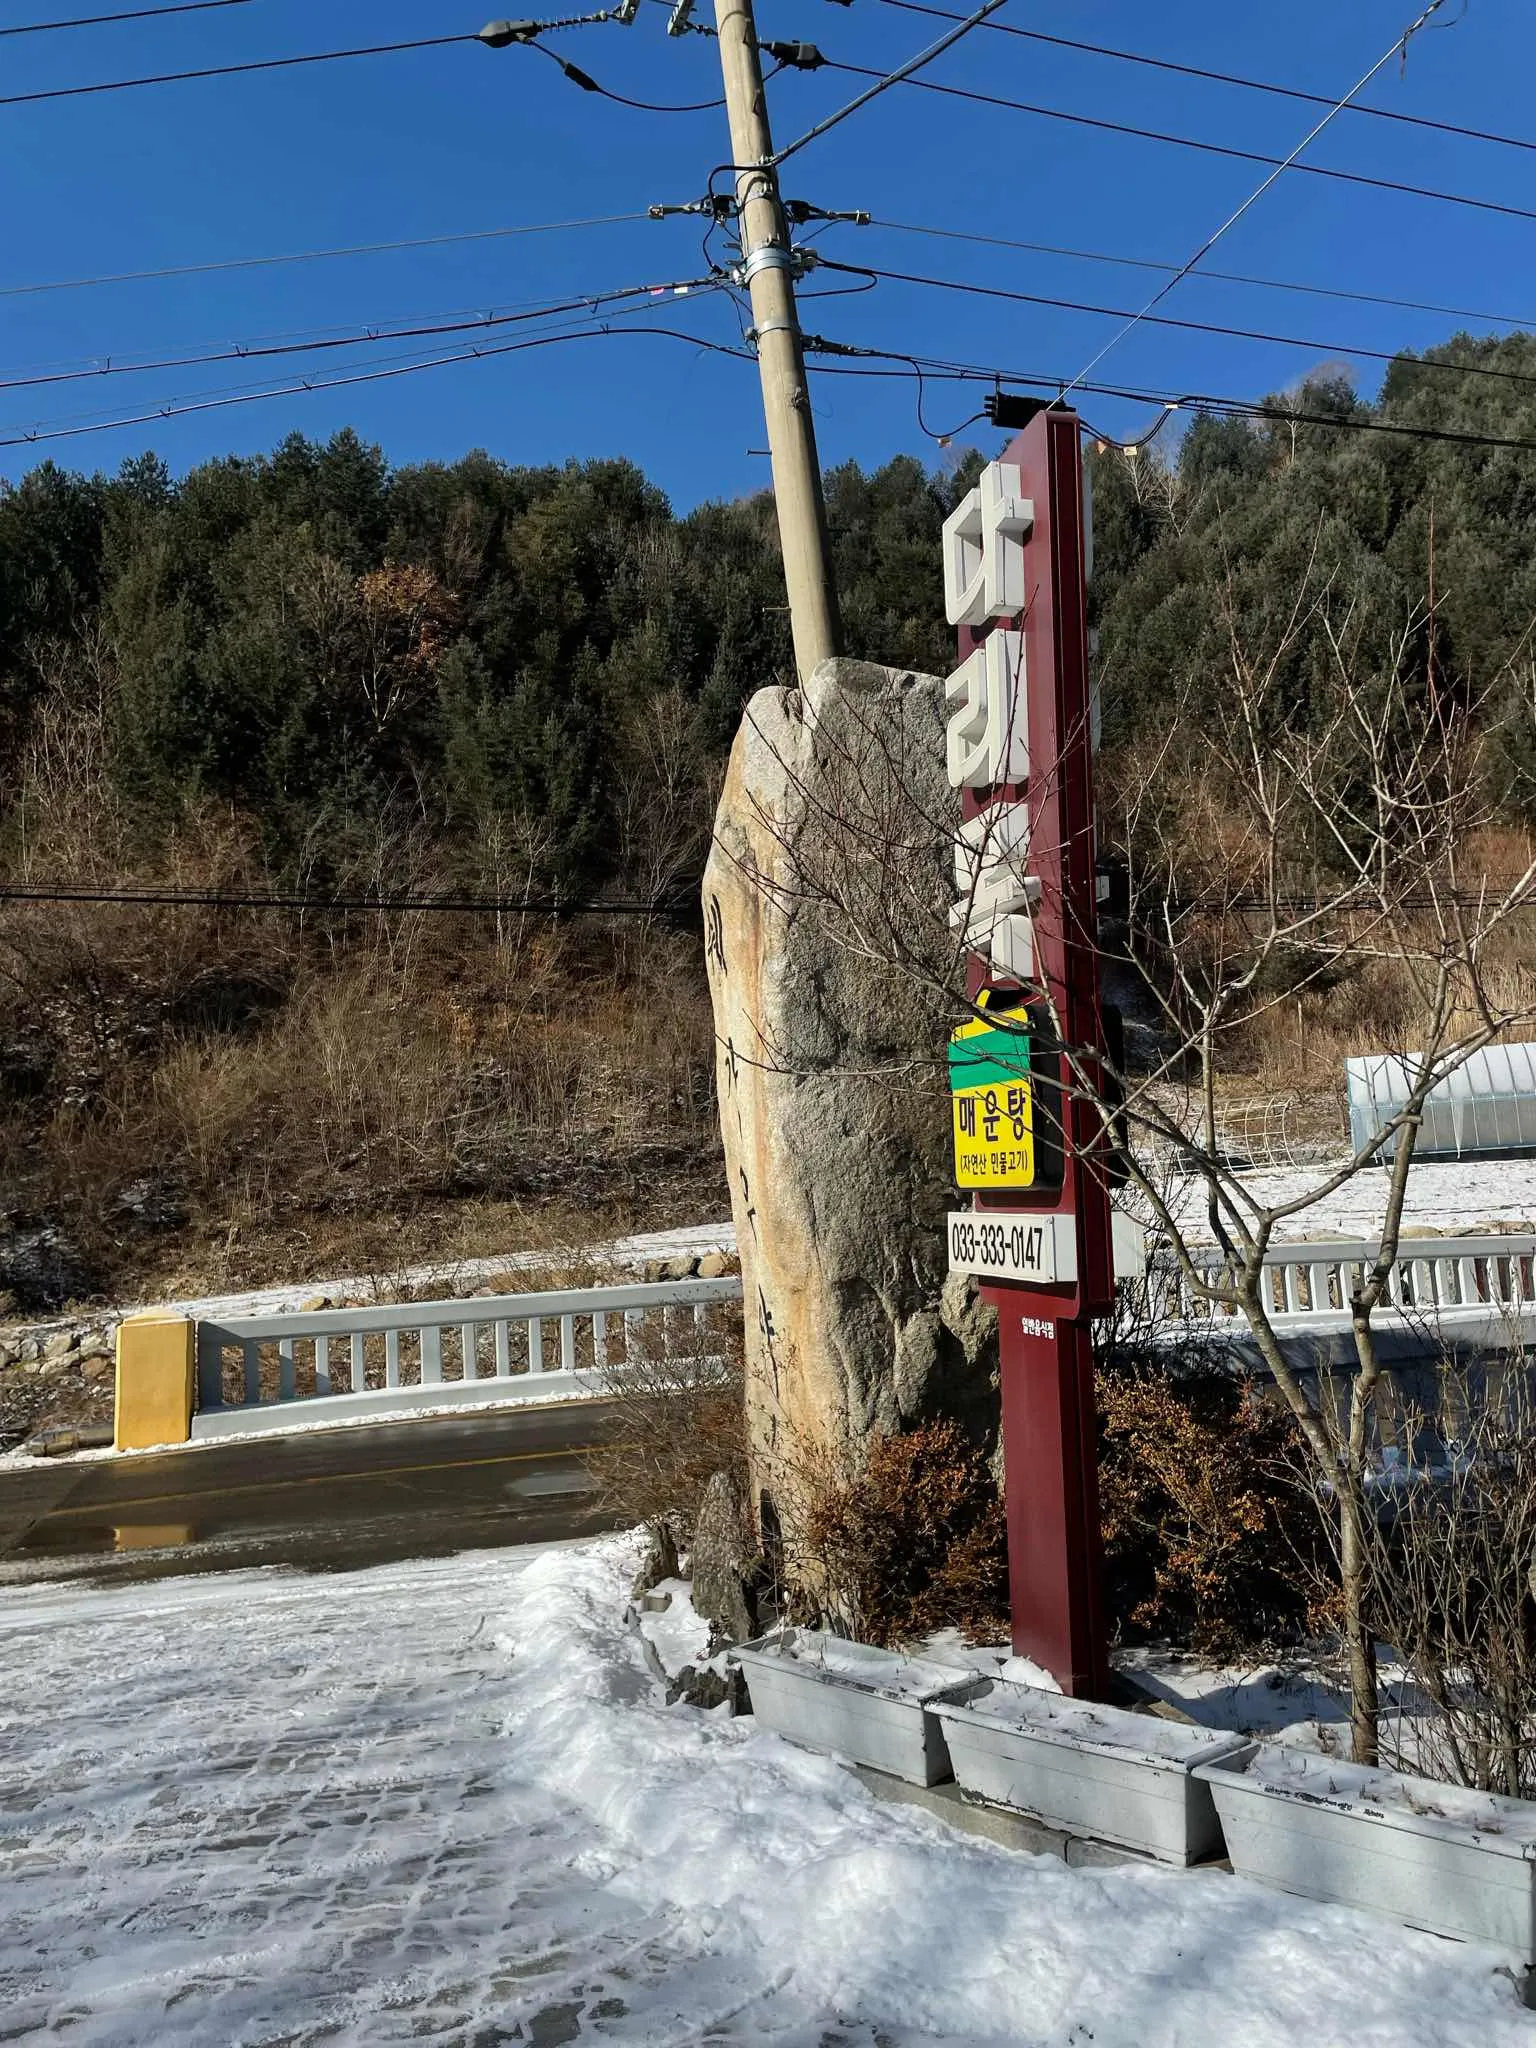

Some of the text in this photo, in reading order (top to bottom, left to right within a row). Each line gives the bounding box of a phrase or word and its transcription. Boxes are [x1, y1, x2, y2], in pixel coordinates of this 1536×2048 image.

[959, 1087, 1026, 1142] 매운탕
[960, 1153, 987, 1175] (자연산
[952, 1223, 1043, 1271] 033-333-0147
[1022, 1317, 1055, 1340] 일반음식점
